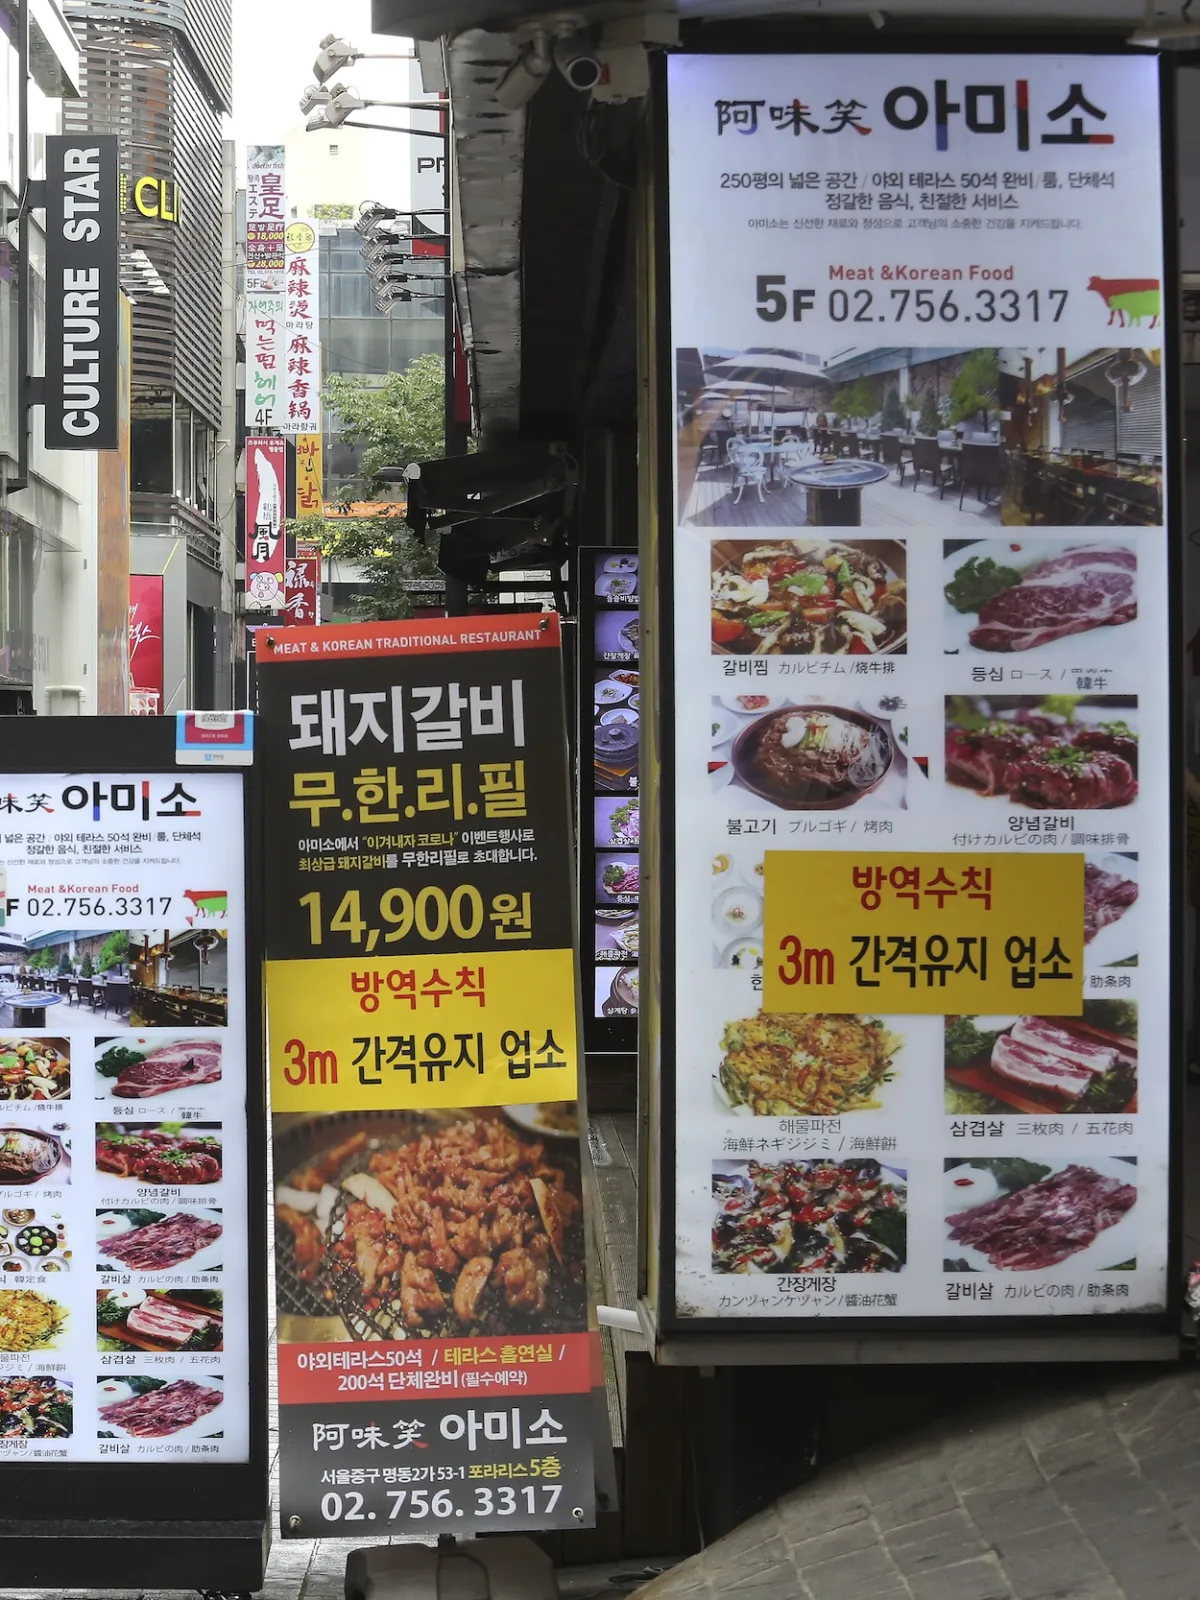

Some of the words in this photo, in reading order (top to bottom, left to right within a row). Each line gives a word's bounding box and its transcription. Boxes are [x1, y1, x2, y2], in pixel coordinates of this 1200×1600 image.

[714, 98, 872, 136] 阿味笑
[883, 78, 1114, 151] 아미소
[720, 172, 783, 190] 250평의
[788, 172, 820, 189] 넓은
[825, 172, 857, 189] 공간
[871, 172, 904, 189] 야외
[908, 172, 956, 189] 테라스
[960, 172, 997, 189] 50석
[1067, 171, 1115, 189] 단체석
[62, 147, 101, 243] STAR
[135, 176, 182, 224] CLI
[828, 264, 874, 281] Meat
[968, 264, 1014, 281] Food
[755, 275, 815, 323] 5F
[828, 289, 1069, 323] 02.756.3317
[62, 267, 101, 437] CULTURE
[255, 408, 273, 426] 4F
[274, 642, 307, 655] MEAT
[310, 641, 320, 652] &
[323, 639, 373, 652] KOREAN
[376, 633, 458, 649] TRADITIONAL
[460, 629, 542, 644] RESTAURANT
[722, 660, 770, 677] 갈비찜
[289, 679, 525, 756] 돼지갈비
[61, 780, 201, 821] 아미소
[289, 760, 527, 828] 무.한.리.필
[726, 818, 777, 836] 불고기
[863, 820, 893, 834] 烤肉
[1007, 815, 1075, 832] 양념갈비
[298, 836, 359, 853] 아미소에서
[462, 828, 535, 846] 이벤트행사로
[299, 857, 336, 872] 최상급
[337, 854, 398, 870] 돼지갈비를
[401, 851, 470, 869] 무한리필로
[473, 848, 538, 864] 초대합니다.
[852, 866, 993, 911] 방역수칙
[27, 897, 172, 917] 02.756.3317
[777, 934, 835, 986] 3m
[849, 934, 988, 989] 간격유지
[1004, 934, 1073, 989] 업소
[351, 966, 486, 1013] 방역수칙
[284, 1038, 338, 1086] 3m
[352, 1032, 485, 1085] 간격유지
[500, 1029, 567, 1080] 업소
[950, 1120, 1005, 1138] 삼겹살
[945, 1282, 994, 1300] 갈비살
[100, 1354, 136, 1365] 삼겹살
[297, 1348, 423, 1372] 야외테라스50석
[444, 1346, 497, 1366] 테라스
[499, 1344, 554, 1364] 흡연실
[337, 1372, 385, 1392] 200석
[388, 1370, 459, 1390] 단체완비
[461, 1370, 528, 1388] (필수예약)
[313, 1418, 429, 1451] 阿味笑
[439, 1407, 568, 1451] 아미소
[320, 1467, 381, 1485] 서울중구
[383, 1466, 435, 1484] 명동2가
[437, 1466, 465, 1481] 53-1
[468, 1462, 528, 1480] 포라리스
[529, 1456, 562, 1477] 5층
[474, 1484, 563, 1516] 3317
